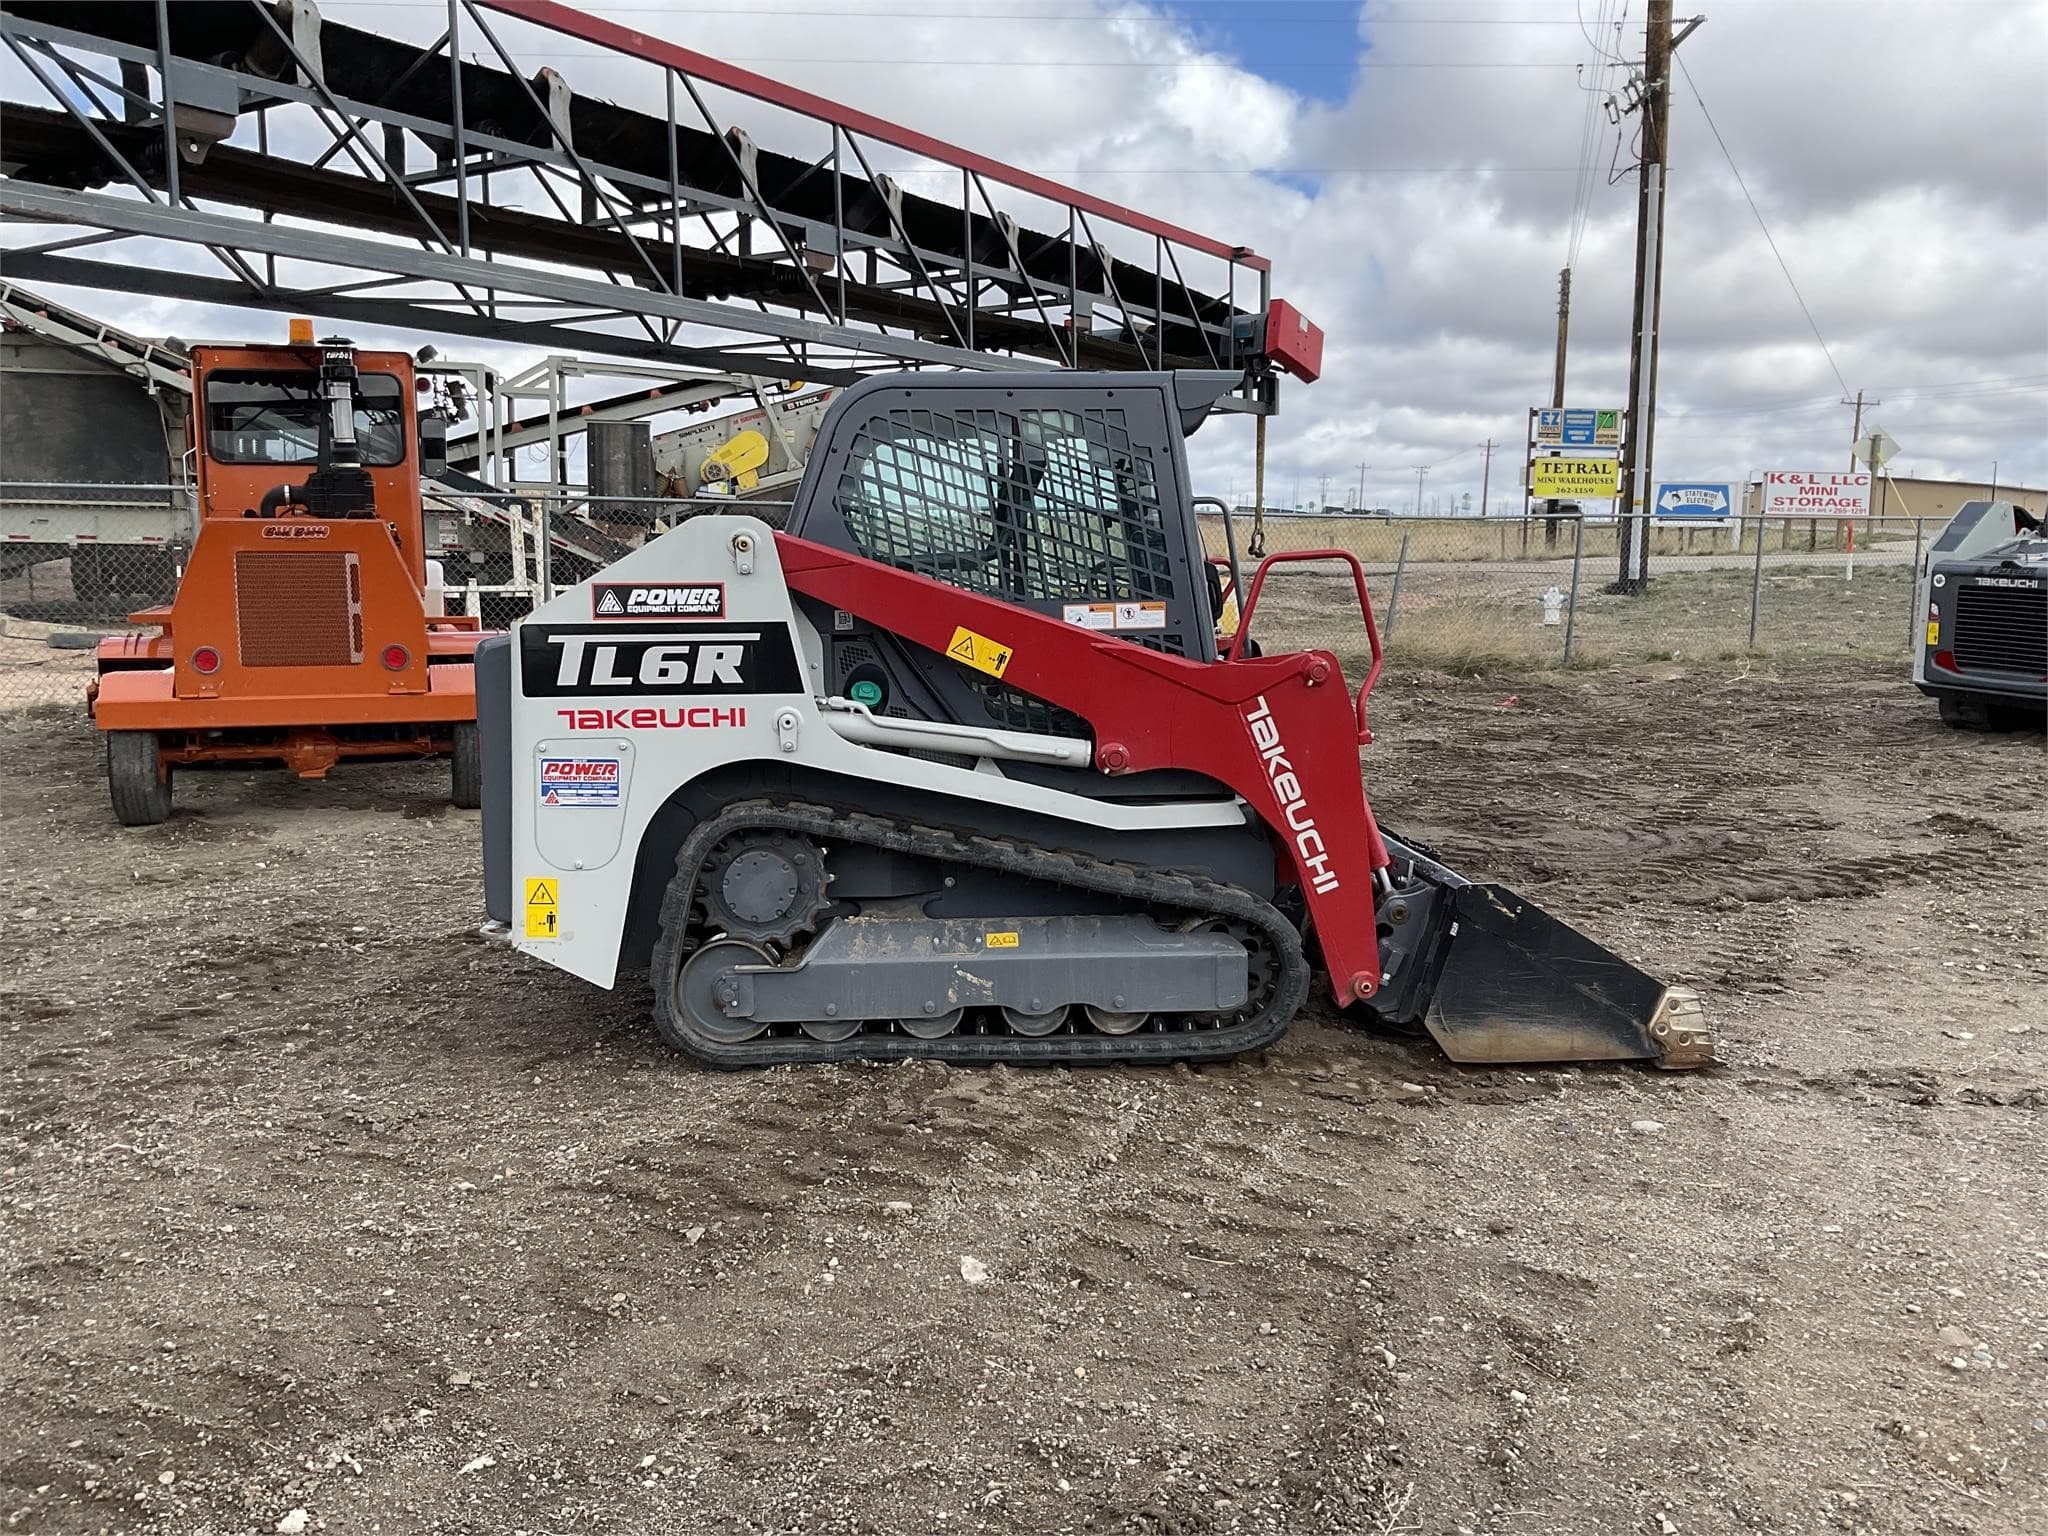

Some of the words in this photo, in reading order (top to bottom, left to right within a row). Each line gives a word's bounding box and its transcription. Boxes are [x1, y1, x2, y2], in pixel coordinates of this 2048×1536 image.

[795, 396, 820, 407] TEREX
[1541, 412, 1560, 425] EZ
[678, 424, 716, 438] SIMPLICITY
[1542, 463, 1612, 475] TETRAL
[1558, 477, 1614, 485] WAREHOUSES
[1769, 473, 1786, 484] K
[1789, 474, 1803, 485] &
[1809, 474, 1821, 485] L
[1831, 475, 1869, 486] LLC
[1685, 490, 1718, 500] STATEWIDE
[1799, 486, 1838, 496] MINI
[1686, 498, 1715, 506] ELECTRIC
[1773, 497, 1862, 507] STORAGE
[627, 589, 720, 605] POWER
[627, 605, 676, 613] EQUIPMENT
[677, 605, 720, 613] COMPANY
[548, 633, 761, 686] TL6R
[544, 763, 618, 775] POWER
